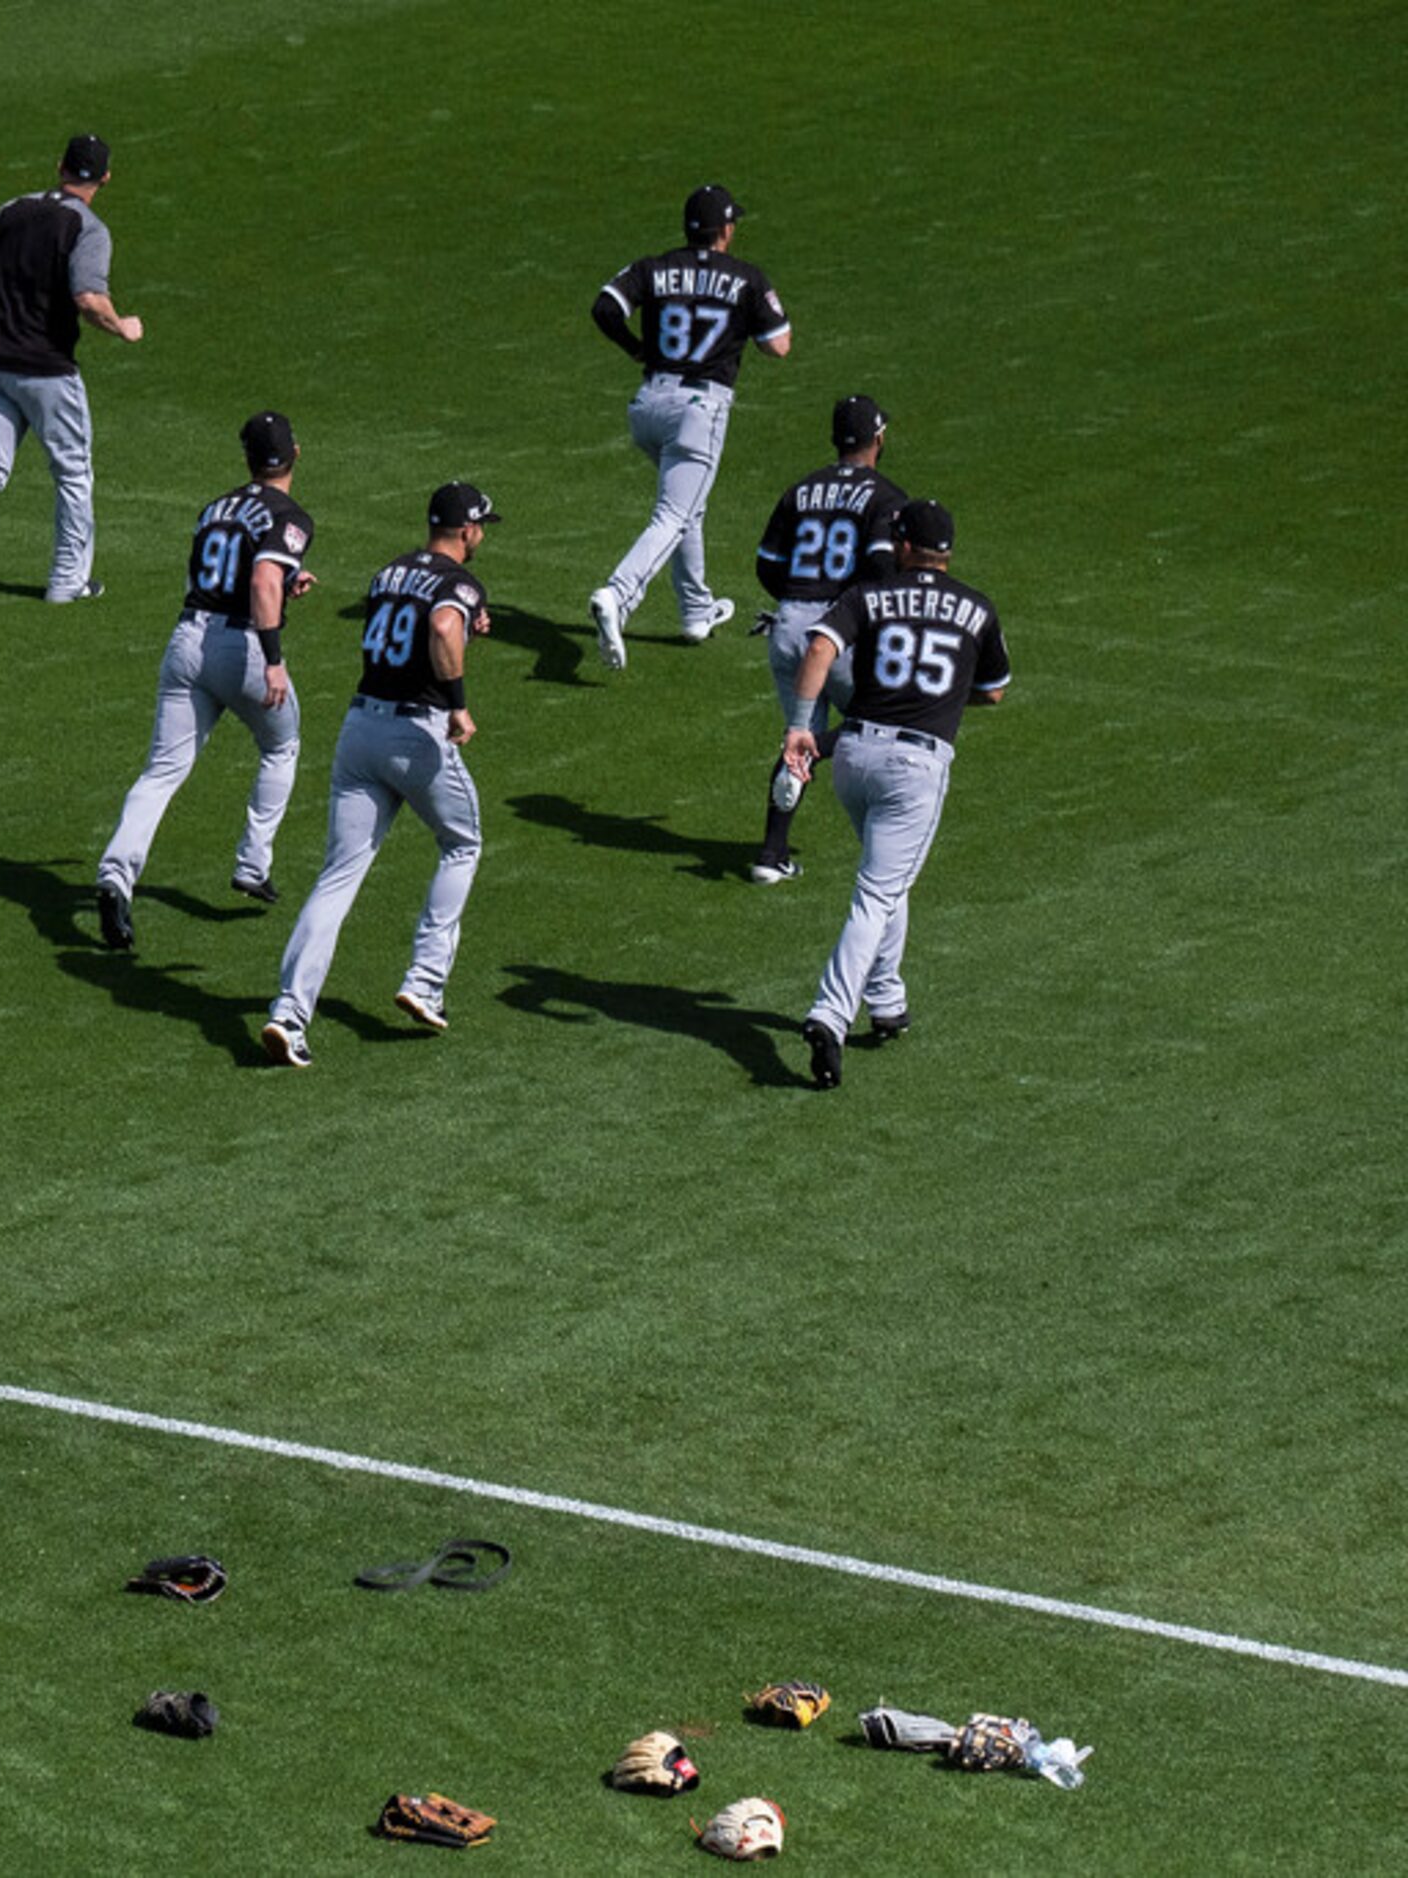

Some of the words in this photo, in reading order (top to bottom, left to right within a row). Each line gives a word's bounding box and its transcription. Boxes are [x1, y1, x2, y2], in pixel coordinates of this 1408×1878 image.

[653, 267, 748, 307] MENDICK
[659, 303, 730, 362] 87
[197, 529, 243, 593] 91
[790, 517, 858, 580] 28
[361, 601, 417, 667] 49
[864, 587, 988, 638] PETERSON
[874, 622, 963, 697] 85
